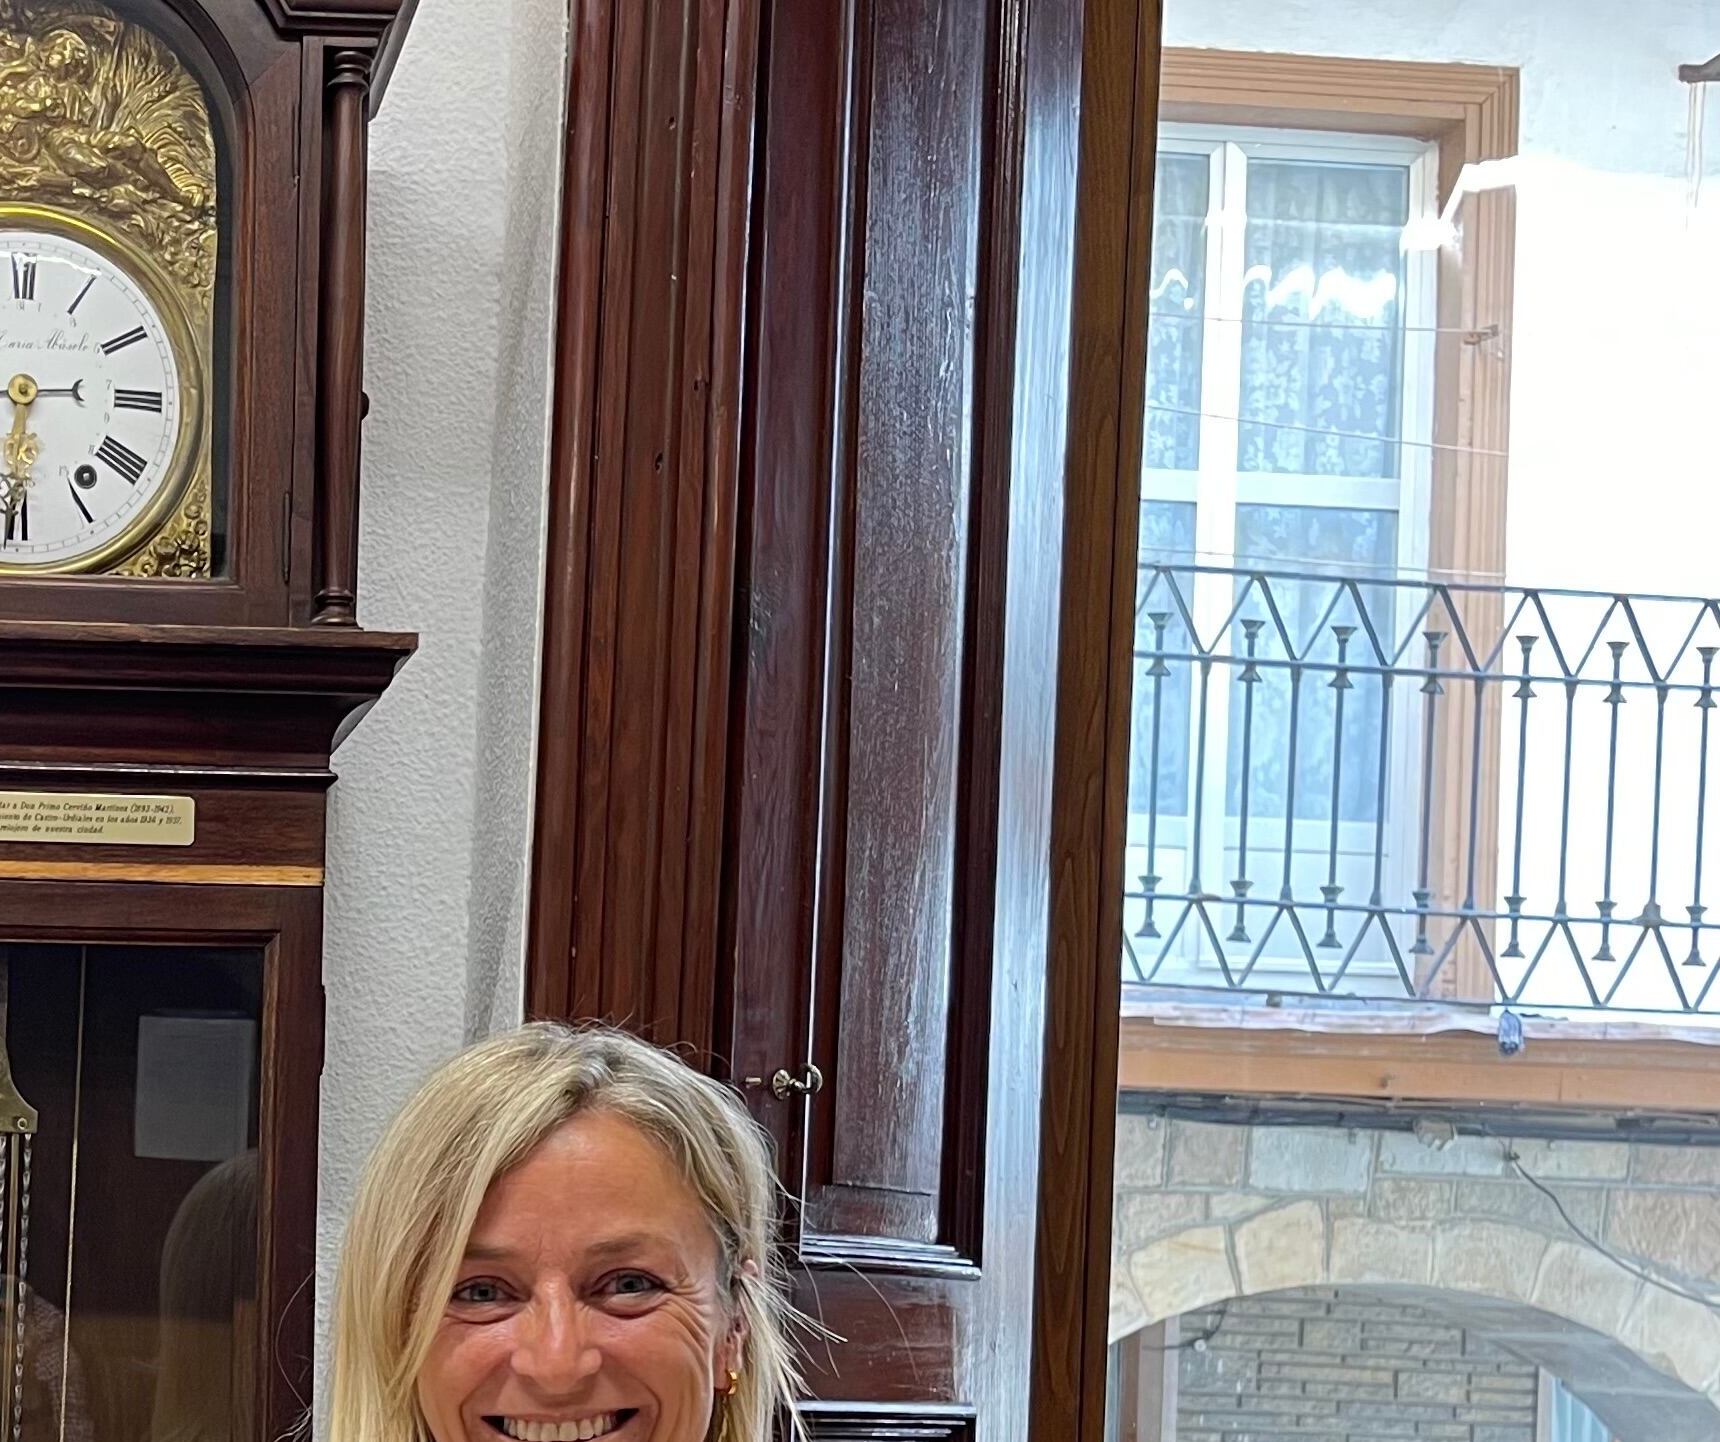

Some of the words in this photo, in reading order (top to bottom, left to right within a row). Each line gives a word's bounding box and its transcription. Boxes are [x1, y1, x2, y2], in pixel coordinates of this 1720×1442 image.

[100, 325, 149, 356] II
[114, 388, 162, 413] III
[94, 435, 148, 486] IIII
[20, 801, 35, 810] Don
[38, 801, 61, 811] Primo
[23, 812, 32, 821] de
[107, 815, 119, 824] los
[0, 823, 29, 833] relojero
[31, 824, 41, 832] de
[45, 825, 73, 834] nuestra
